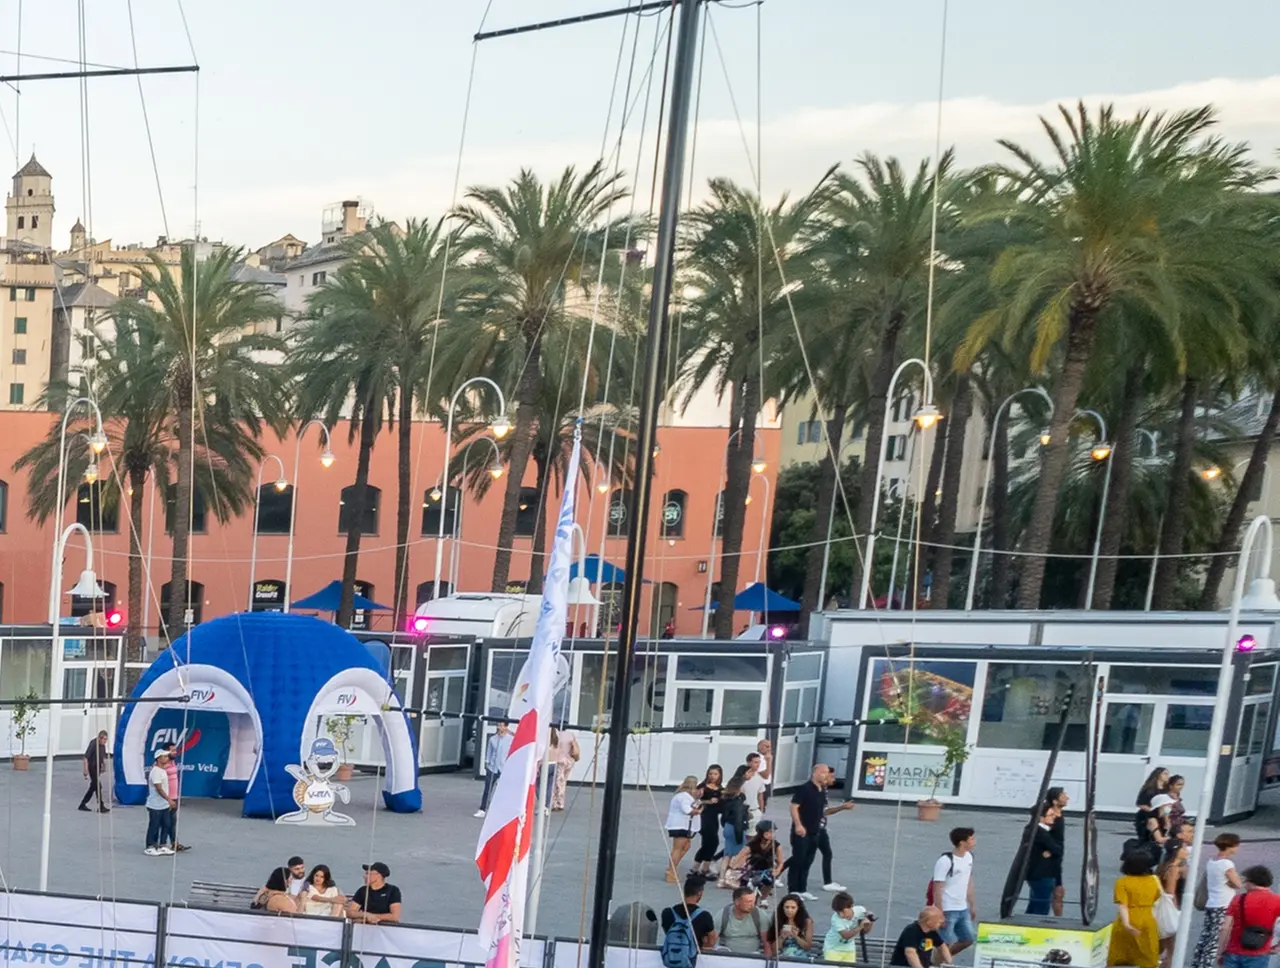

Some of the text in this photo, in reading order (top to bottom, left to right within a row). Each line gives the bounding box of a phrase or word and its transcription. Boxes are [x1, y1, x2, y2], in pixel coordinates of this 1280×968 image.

[190, 690, 209, 701] FIV
[151, 727, 189, 751] FIV
[197, 763, 219, 773] Vela
